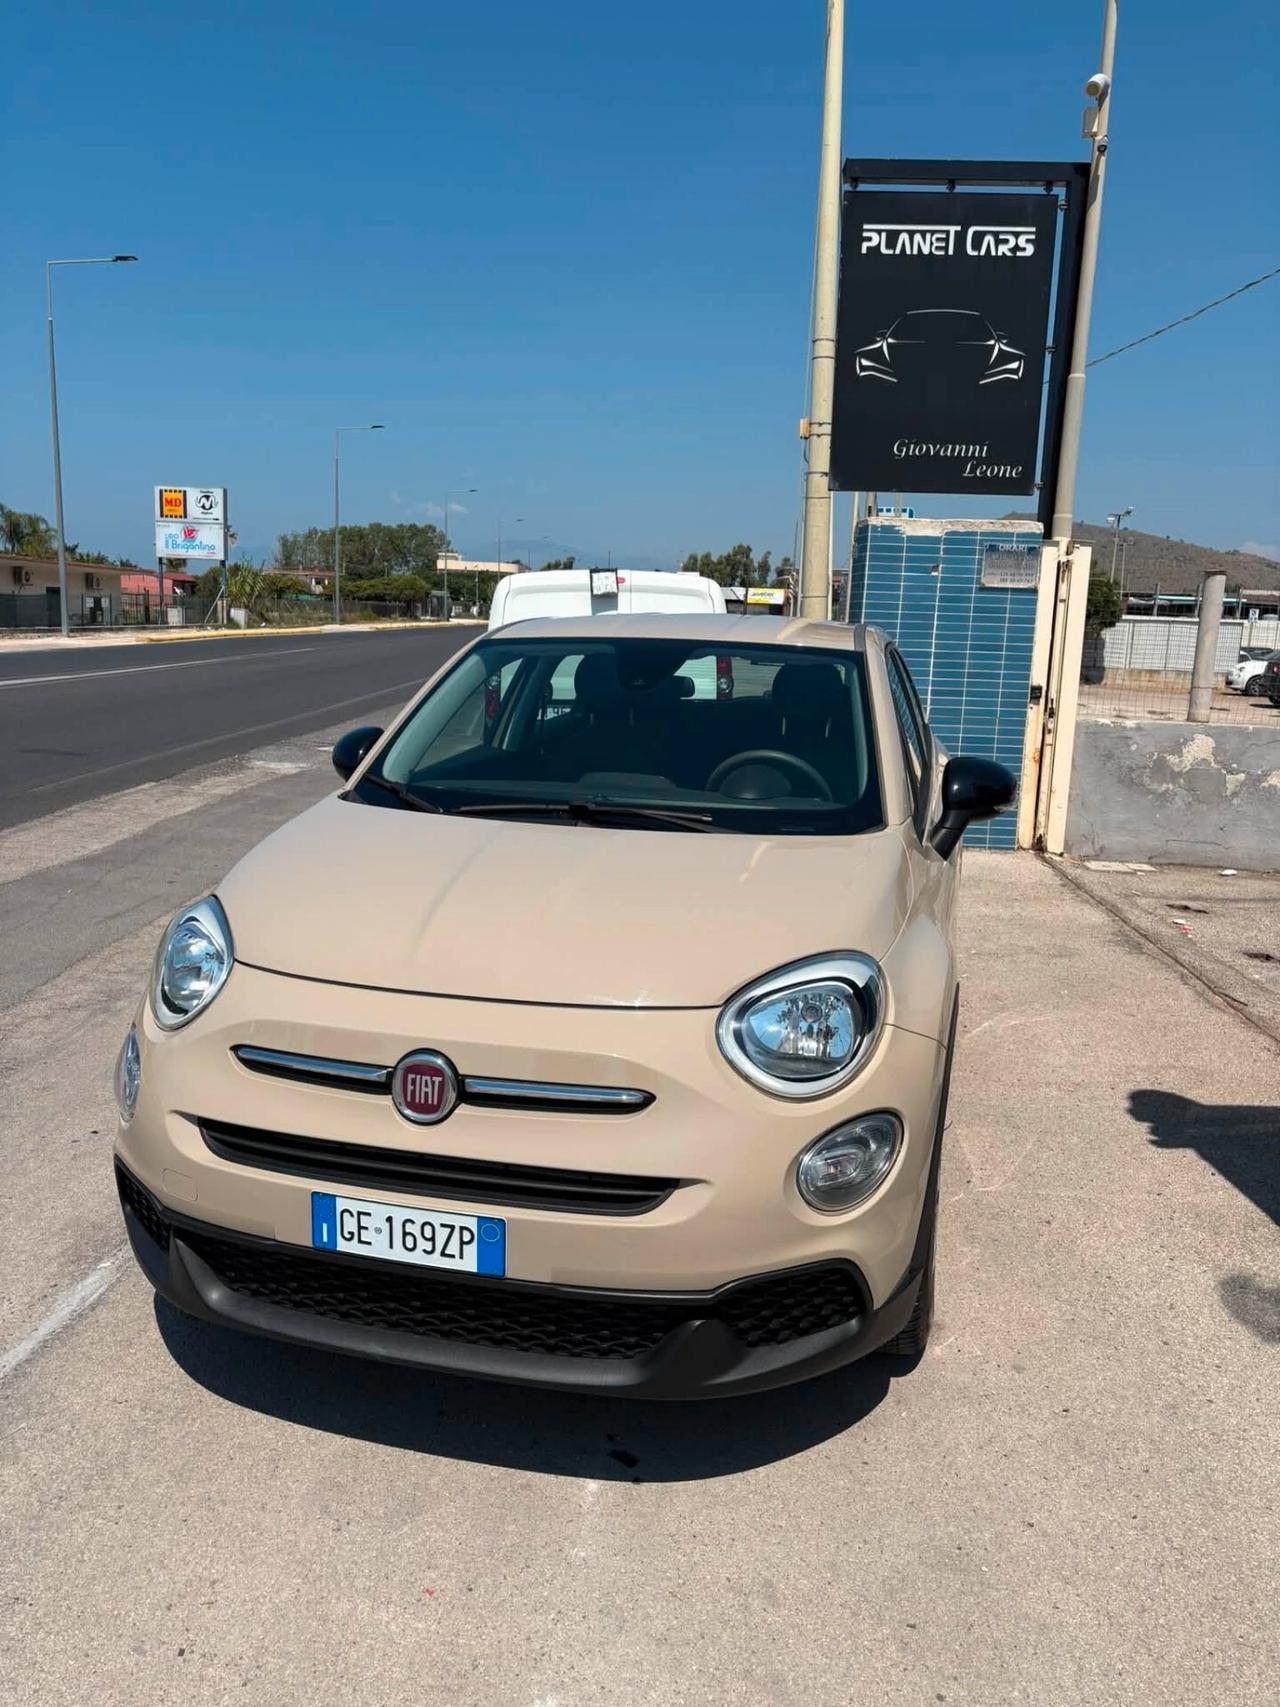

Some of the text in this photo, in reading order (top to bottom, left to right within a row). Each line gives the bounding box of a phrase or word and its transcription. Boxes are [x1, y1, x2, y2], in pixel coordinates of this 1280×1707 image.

[861, 223, 1036, 257] PLANET CARS
[893, 439, 989, 459] Giovanni
[962, 460, 1023, 478] Leone
[164, 497, 182, 507] MD
[407, 1073, 443, 1105] FIAT
